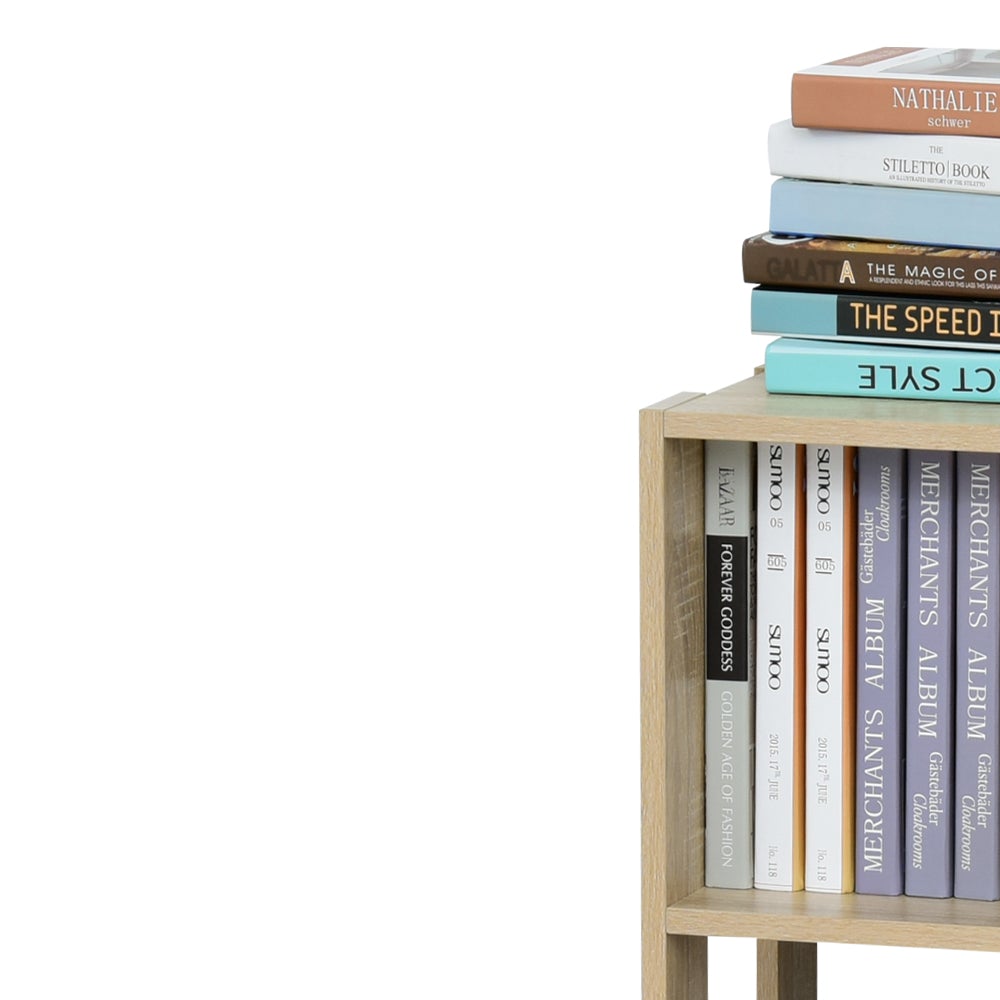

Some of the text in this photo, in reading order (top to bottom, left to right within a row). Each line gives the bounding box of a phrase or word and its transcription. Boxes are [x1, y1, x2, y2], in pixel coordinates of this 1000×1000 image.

[891, 86, 998, 113] NATHALIE
[927, 115, 972, 128] schwer
[883, 158, 990, 180] STILETTO BOOK
[929, 145, 943, 154] THE
[867, 262, 896, 276] THE
[905, 265, 965, 280] MAGIC
[974, 269, 997, 281] OF
[850, 302, 898, 332] THE
[904, 305, 982, 337] SPEED
[858, 364, 940, 392] SYLE
[769, 445, 782, 511] sumoo
[816, 448, 830, 515] sumoo
[875, 465, 891, 542] Cloakrooms
[770, 518, 783, 528] 05
[817, 521, 832, 532] 05
[859, 509, 874, 584] Gästebäder
[767, 556, 788, 567] 605
[815, 560, 836, 571] 605
[720, 543, 733, 672] FOREVER GODDESS
[918, 461, 940, 739] MERCHANTS ALBUM
[967, 463, 991, 740] MERCHANTS ALBUM
[769, 624, 782, 690] sumoo
[816, 628, 830, 694] sumoo
[863, 597, 885, 873] MERCHANTS ALBUM
[720, 691, 733, 868] GOLDEN AGE OF FASHION
[768, 779, 779, 800] JUNE
[929, 751, 944, 827] Gästebäder
[977, 753, 992, 828] Gästebäder
[912, 793, 928, 869] Cloakrooms
[961, 795, 976, 871] Cloakrooms
[768, 862, 778, 878] 118
[817, 866, 827, 882] 118
